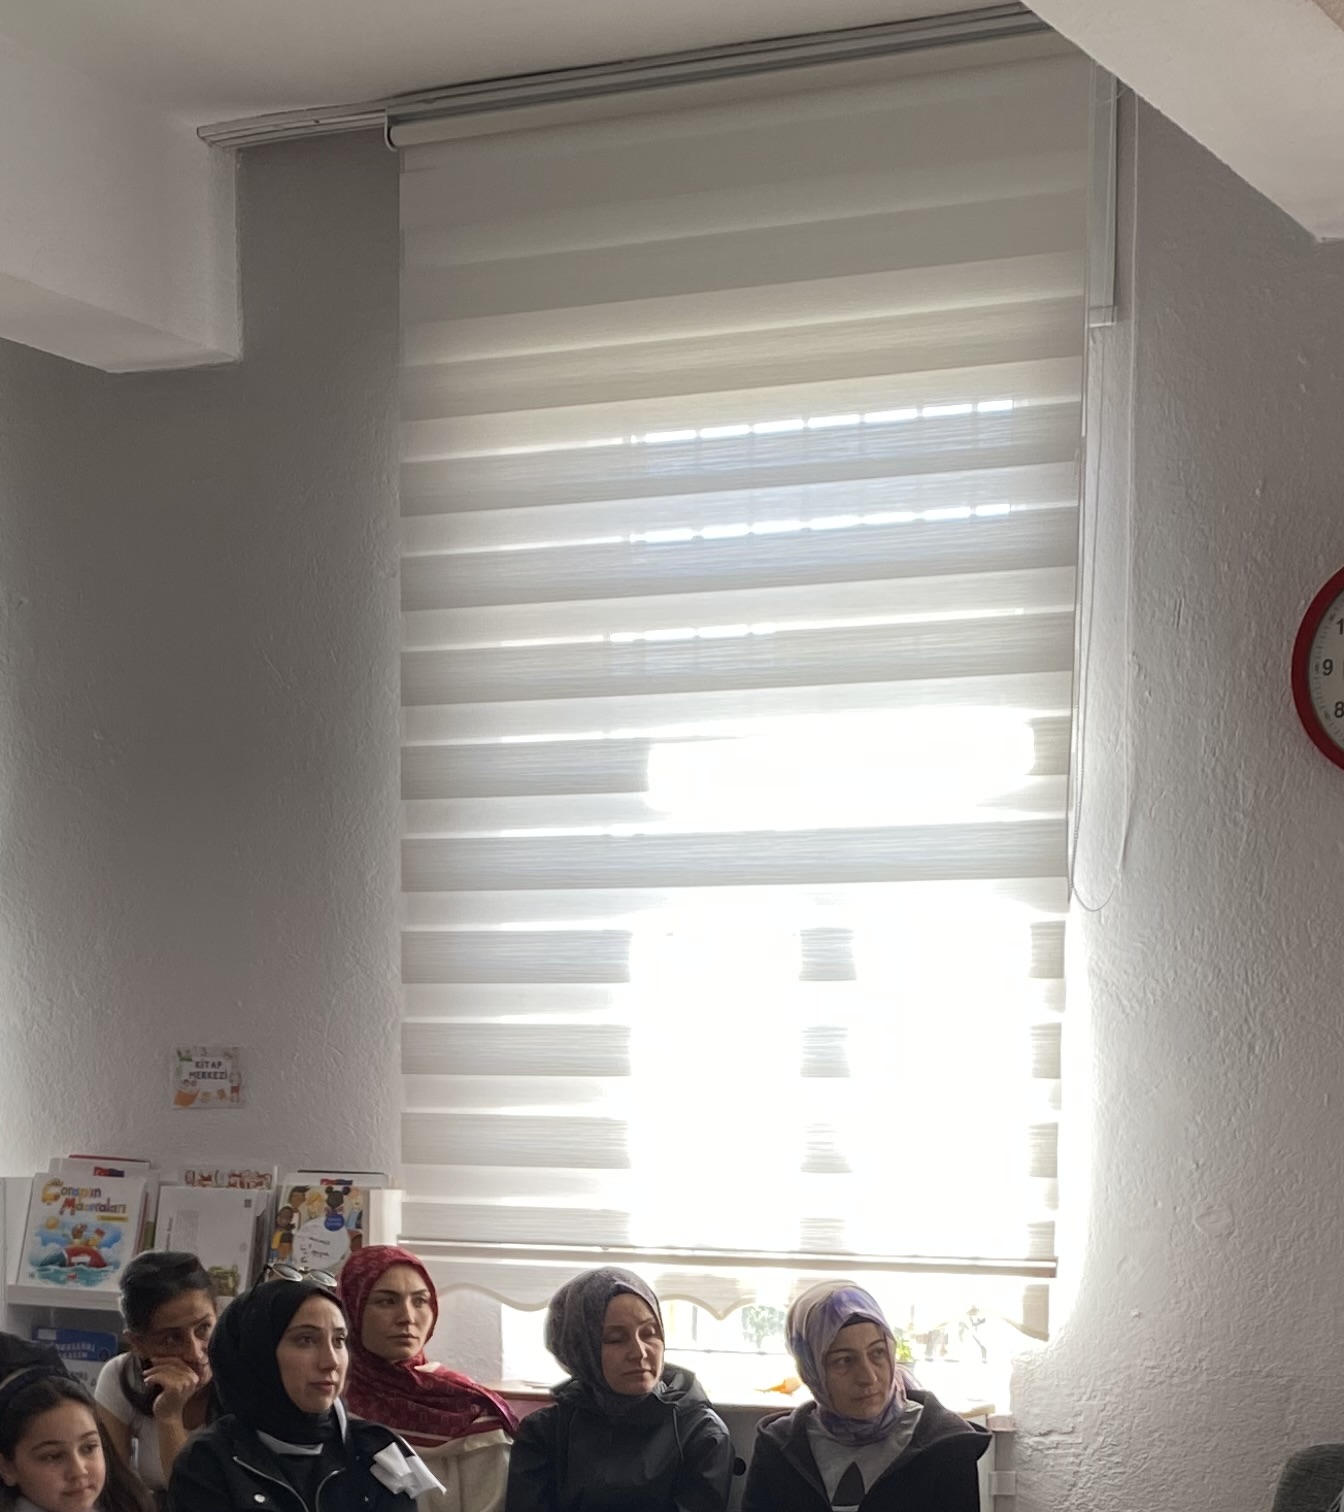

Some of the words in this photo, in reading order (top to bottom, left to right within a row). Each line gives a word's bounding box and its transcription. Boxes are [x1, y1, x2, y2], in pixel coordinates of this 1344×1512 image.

[1322, 659, 1333, 676] 9
[1334, 701, 1344, 718] 8
[195, 1058, 223, 1069] KİTAP
[189, 1070, 228, 1080] MERKEZİ
